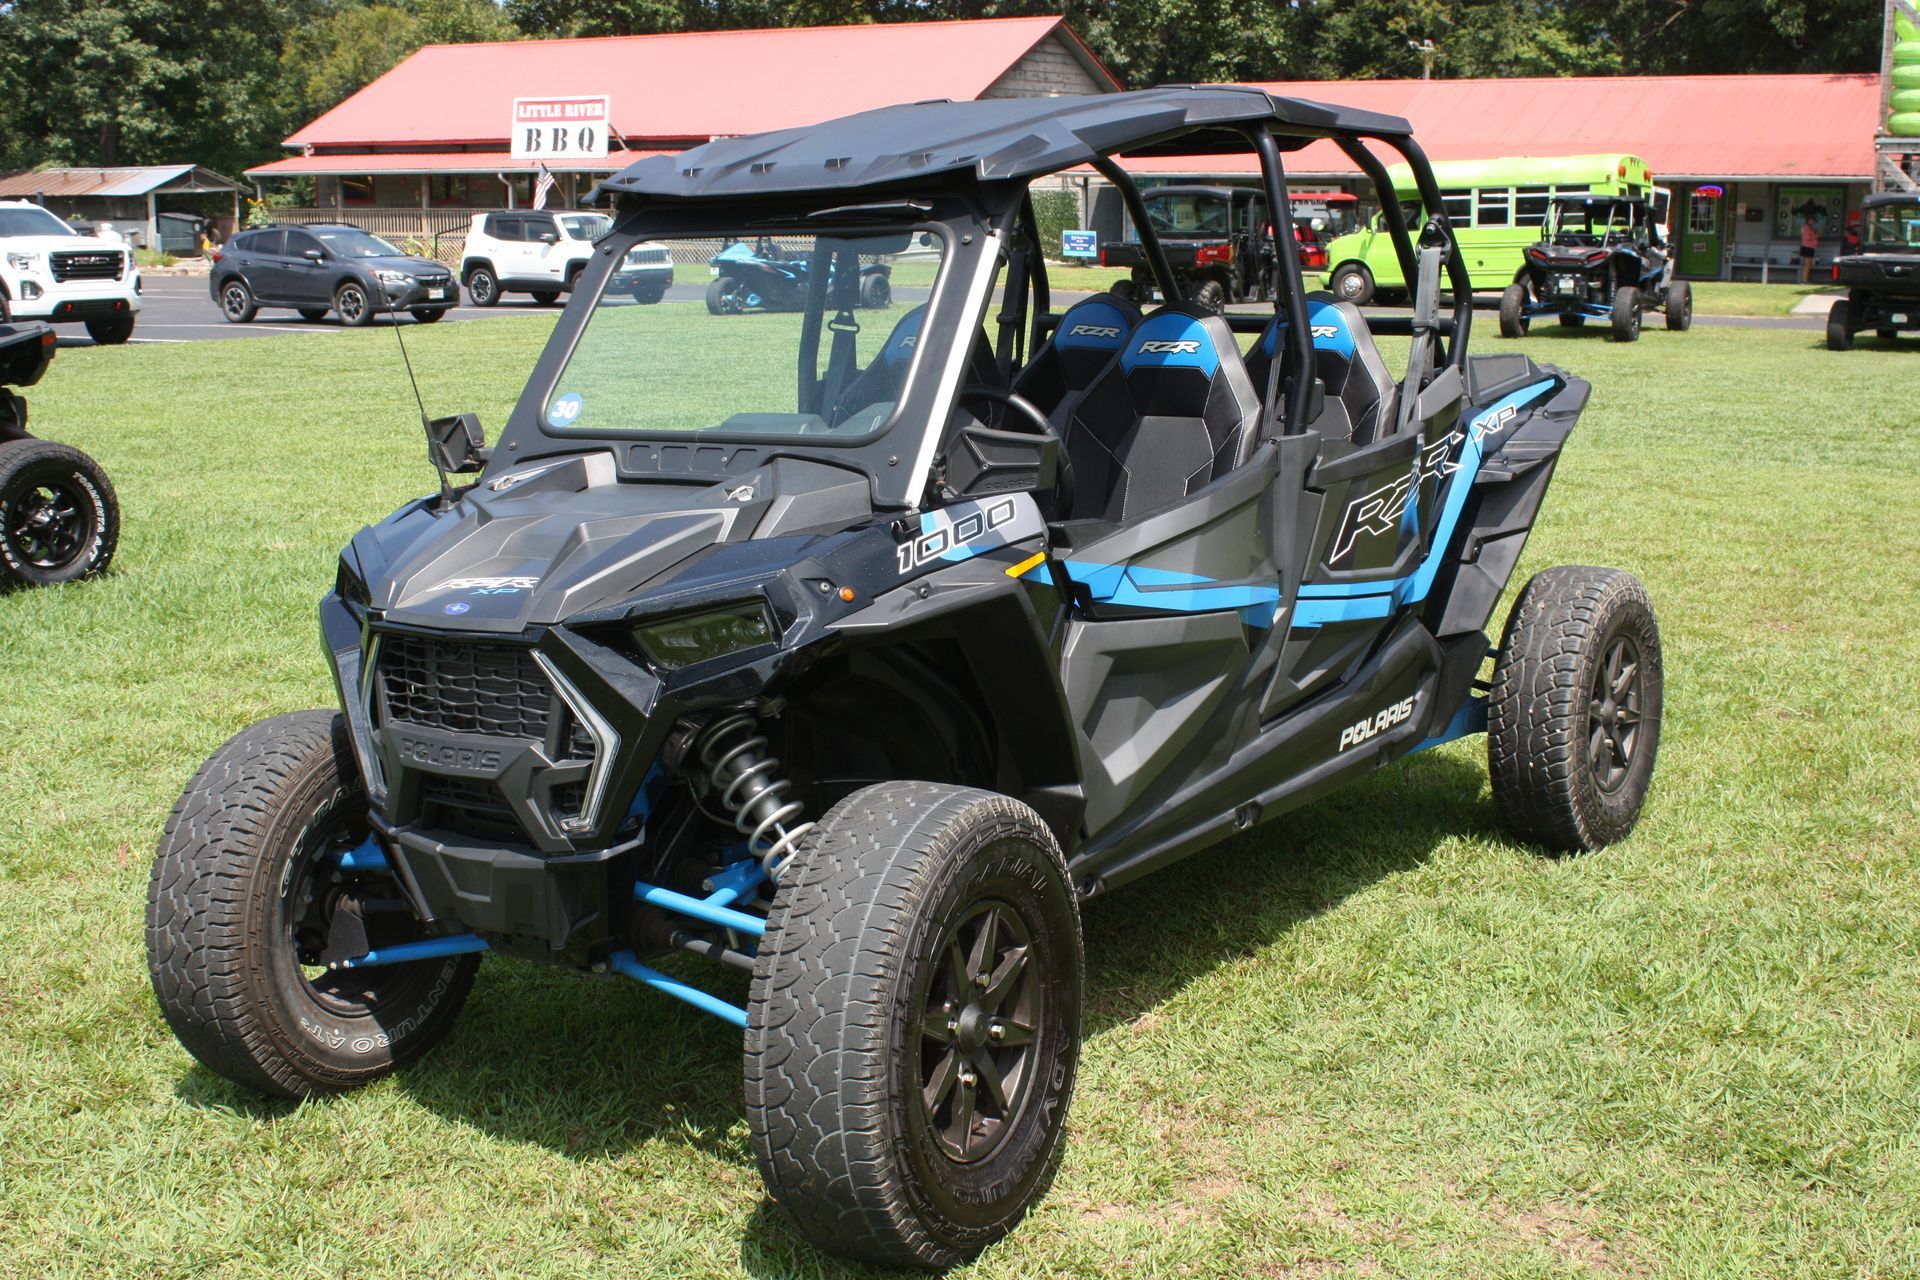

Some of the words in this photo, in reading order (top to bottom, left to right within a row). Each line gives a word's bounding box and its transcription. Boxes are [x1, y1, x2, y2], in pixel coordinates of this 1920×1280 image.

[518, 104, 561, 118] LITTLE
[564, 102, 603, 117] RIVER
[1068, 324, 1121, 338] RZR
[1311, 325, 1338, 338] ZR
[1136, 340, 1201, 355] RZR
[551, 400, 580, 418] 30
[1470, 403, 1517, 444] XP
[985, 477, 1037, 489] POLARIS
[897, 496, 1017, 575] 1000
[1338, 695, 1414, 752] POLARIS
[400, 738, 501, 772] POLARIS
